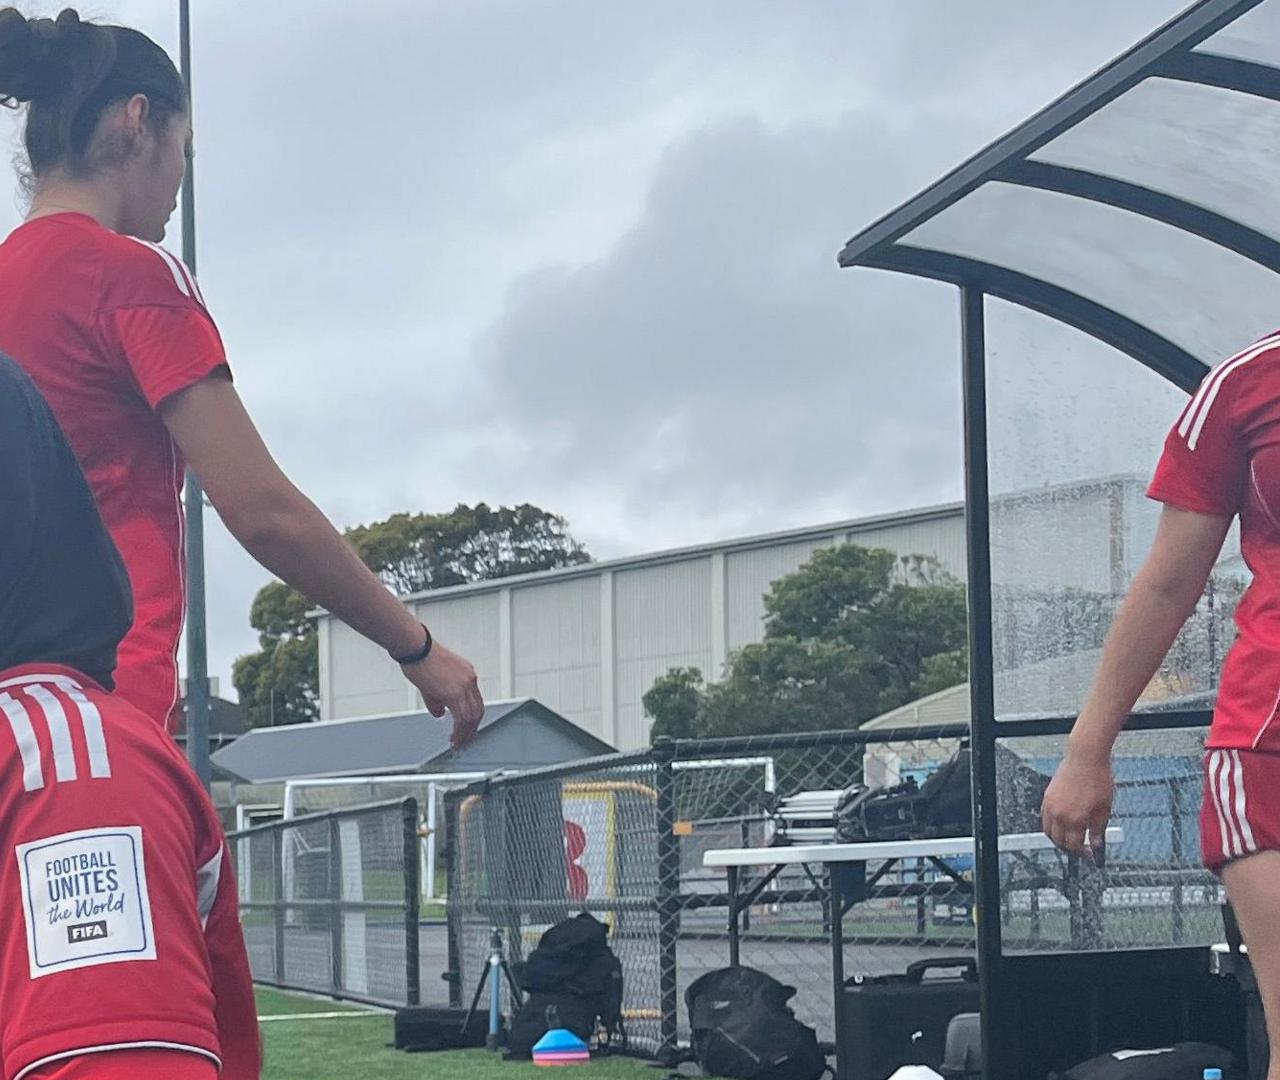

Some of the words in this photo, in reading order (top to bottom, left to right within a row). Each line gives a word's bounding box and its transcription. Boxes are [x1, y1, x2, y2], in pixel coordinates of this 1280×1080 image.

[45, 851, 116, 878] FOOTBALL
[48, 869, 119, 902] UNITES
[46, 903, 72, 925] the
[75, 892, 125, 918] World
[72, 924, 103, 940] FIFA
